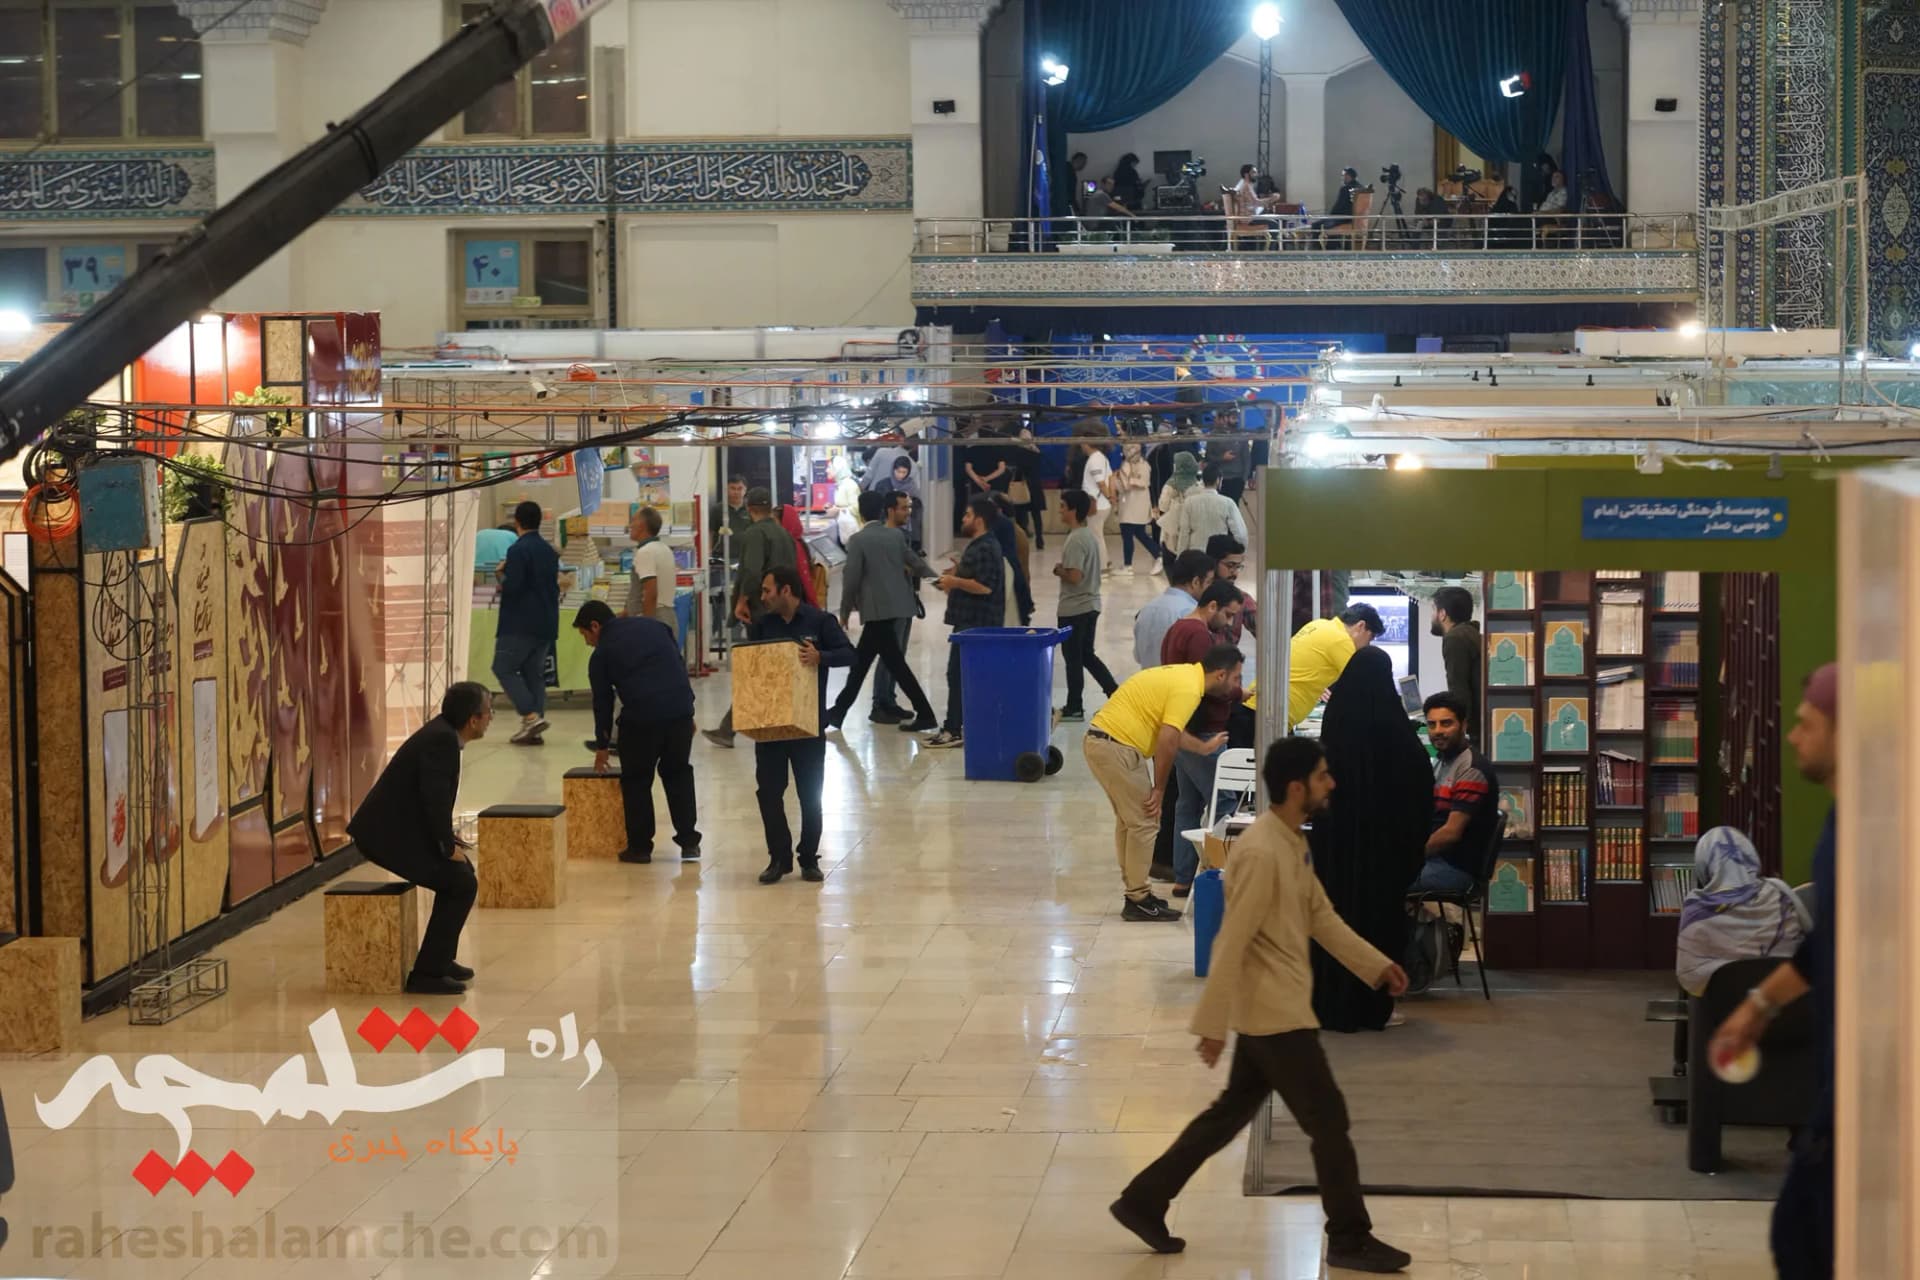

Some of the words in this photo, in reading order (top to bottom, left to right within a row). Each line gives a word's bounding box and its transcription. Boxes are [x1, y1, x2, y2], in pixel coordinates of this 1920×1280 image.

[1593, 504, 1619, 519] امام
[1619, 503, 1676, 519] تحقیقاتی
[1677, 501, 1723, 519] فرهنگی
[1703, 521, 1731, 534] صدر
[1732, 521, 1770, 533] موسی
